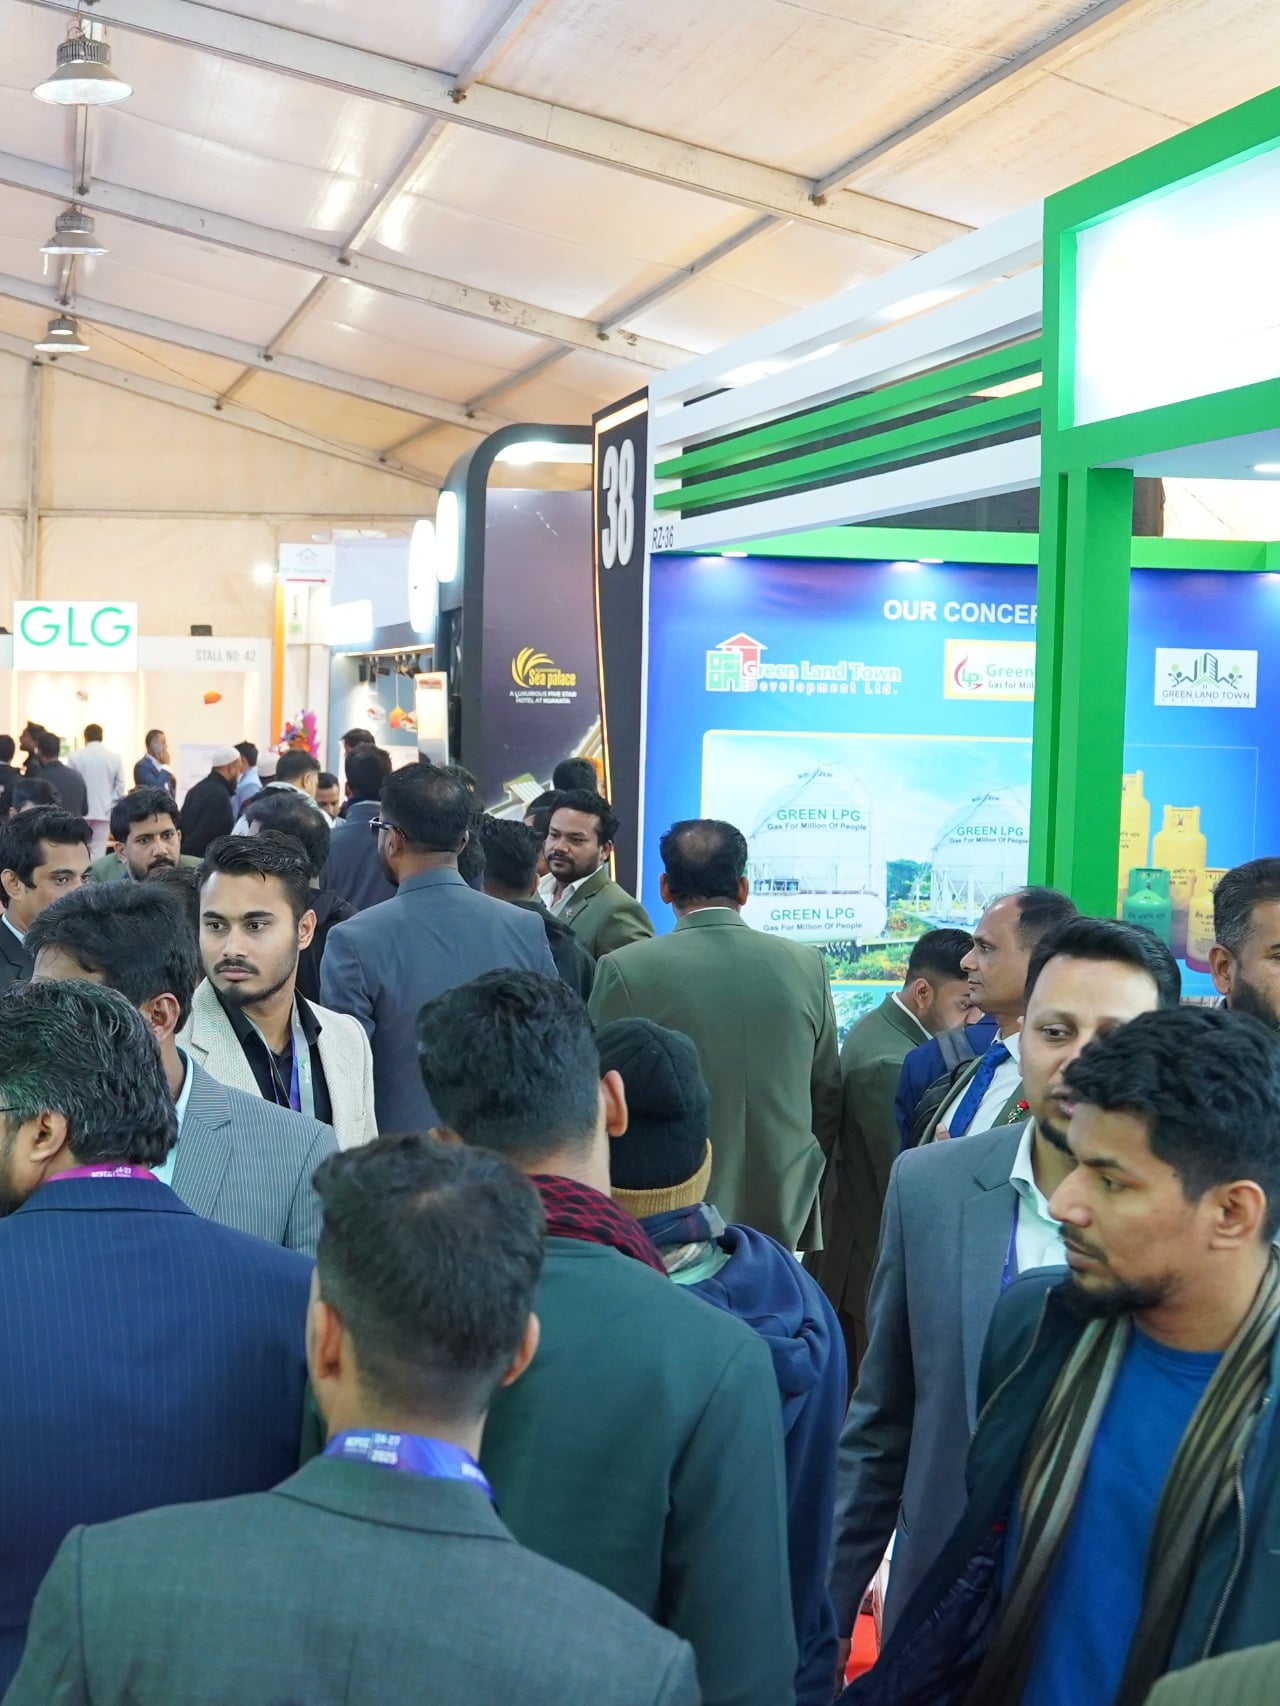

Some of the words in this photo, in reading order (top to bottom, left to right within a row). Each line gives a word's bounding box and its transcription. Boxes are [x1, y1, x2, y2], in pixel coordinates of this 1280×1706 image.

[601, 438, 636, 569] 38
[883, 599, 937, 622] OUR
[20, 606, 131, 647] GLG
[195, 649, 224, 662] STALL
[743, 660, 799, 680] Green
[801, 660, 847, 681] Land
[848, 662, 902, 682] Town
[986, 663, 1034, 678] Green
[528, 668, 546, 686] Sea
[547, 669, 577, 689] palace
[987, 681, 1003, 689] Gas
[1005, 680, 1017, 689] for
[748, 680, 857, 696] Development
[864, 682, 899, 695] Ltd.
[1162, 690, 1192, 699] GREEN
[1194, 690, 1220, 699] LAND
[1222, 691, 1250, 700] TOWN
[776, 808, 827, 821] GREEN
[832, 809, 861, 822] LPG
[767, 823, 782, 831] Gas
[801, 822, 826, 830] Million
[840, 823, 867, 832] People
[956, 825, 996, 837] GREEN
[1000, 826, 1024, 837] LPG
[1008, 837, 1029, 845] People
[770, 908, 821, 921] GREEN
[826, 907, 855, 920] LPG
[763, 924, 779, 932] Gas
[781, 923, 794, 931] For
[796, 922, 823, 930] Million
[836, 921, 862, 931] People
